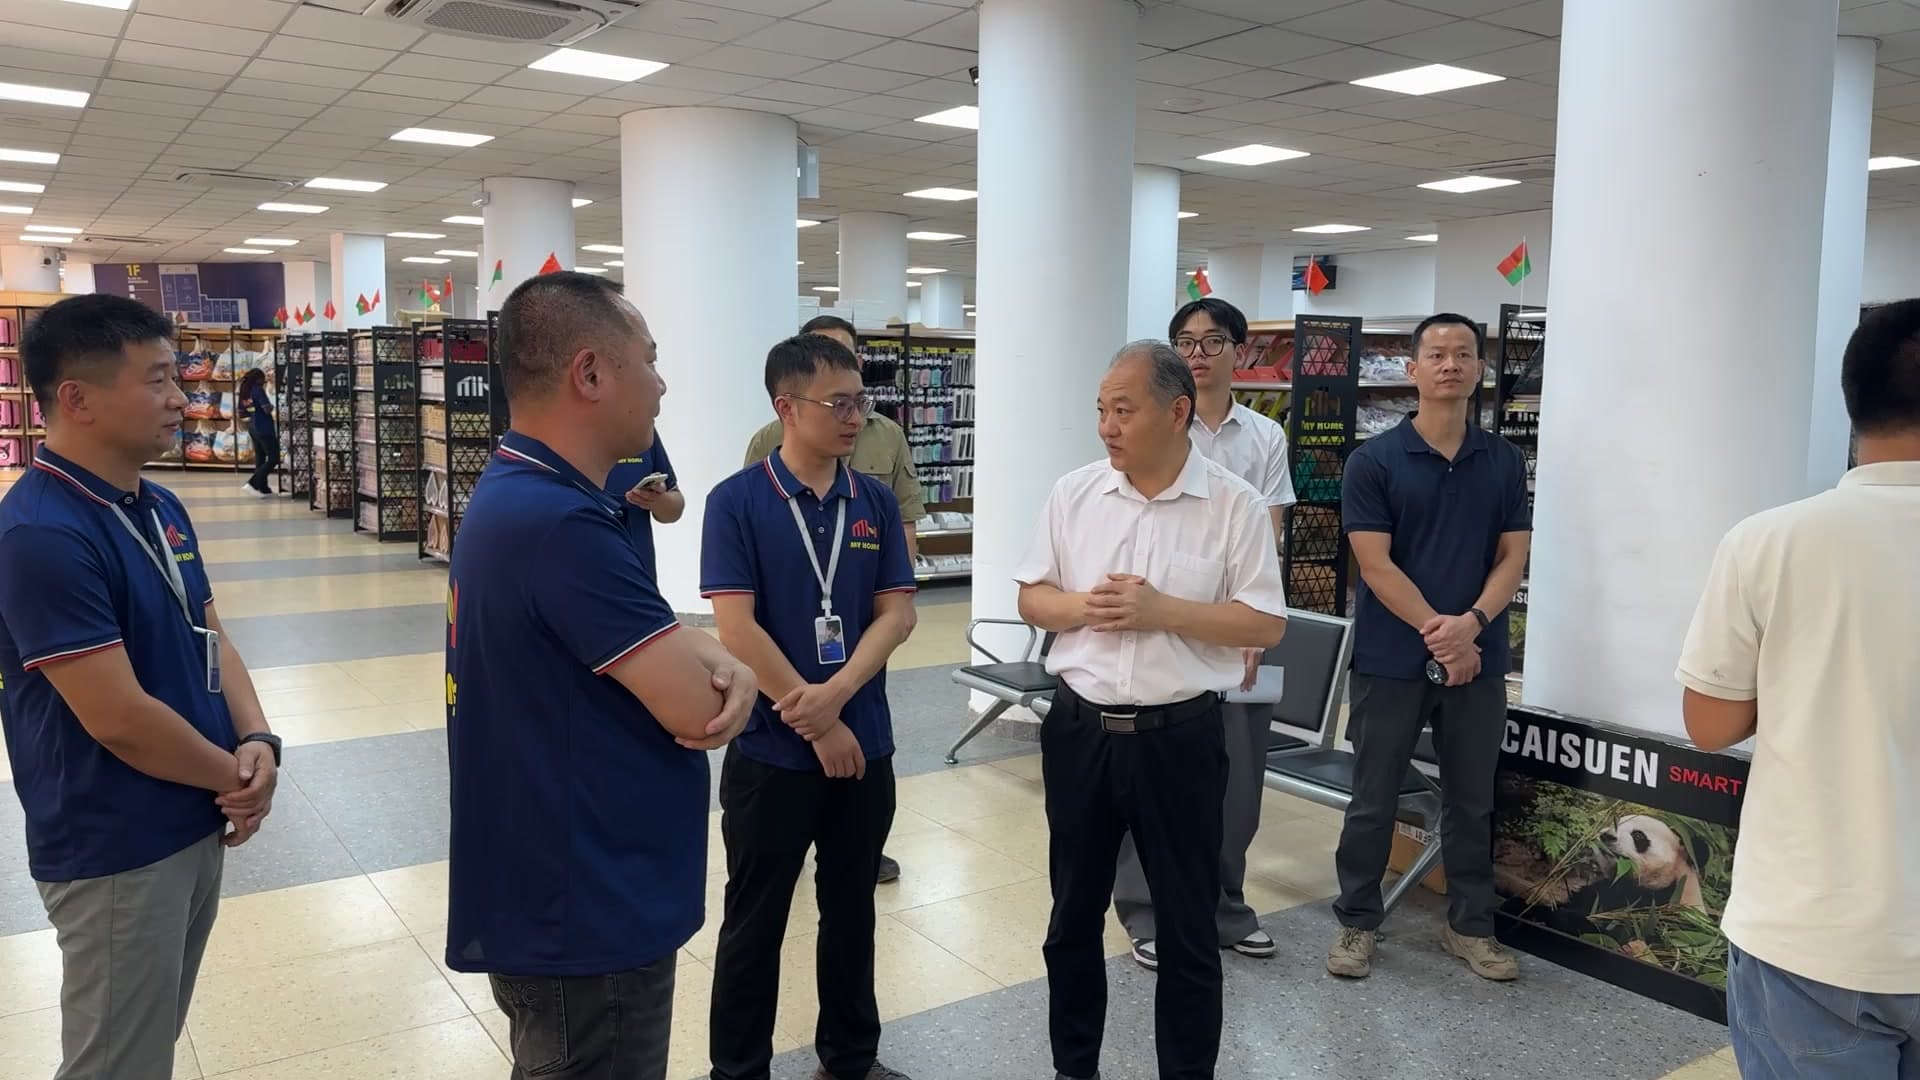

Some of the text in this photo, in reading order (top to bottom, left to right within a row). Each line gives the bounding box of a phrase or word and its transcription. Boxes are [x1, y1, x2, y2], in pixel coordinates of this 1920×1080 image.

[126, 264, 140, 276] 1F
[1316, 421, 1344, 430] HOME
[850, 541, 861, 549] MY
[1501, 719, 1743, 796] CAISUEN SMART
